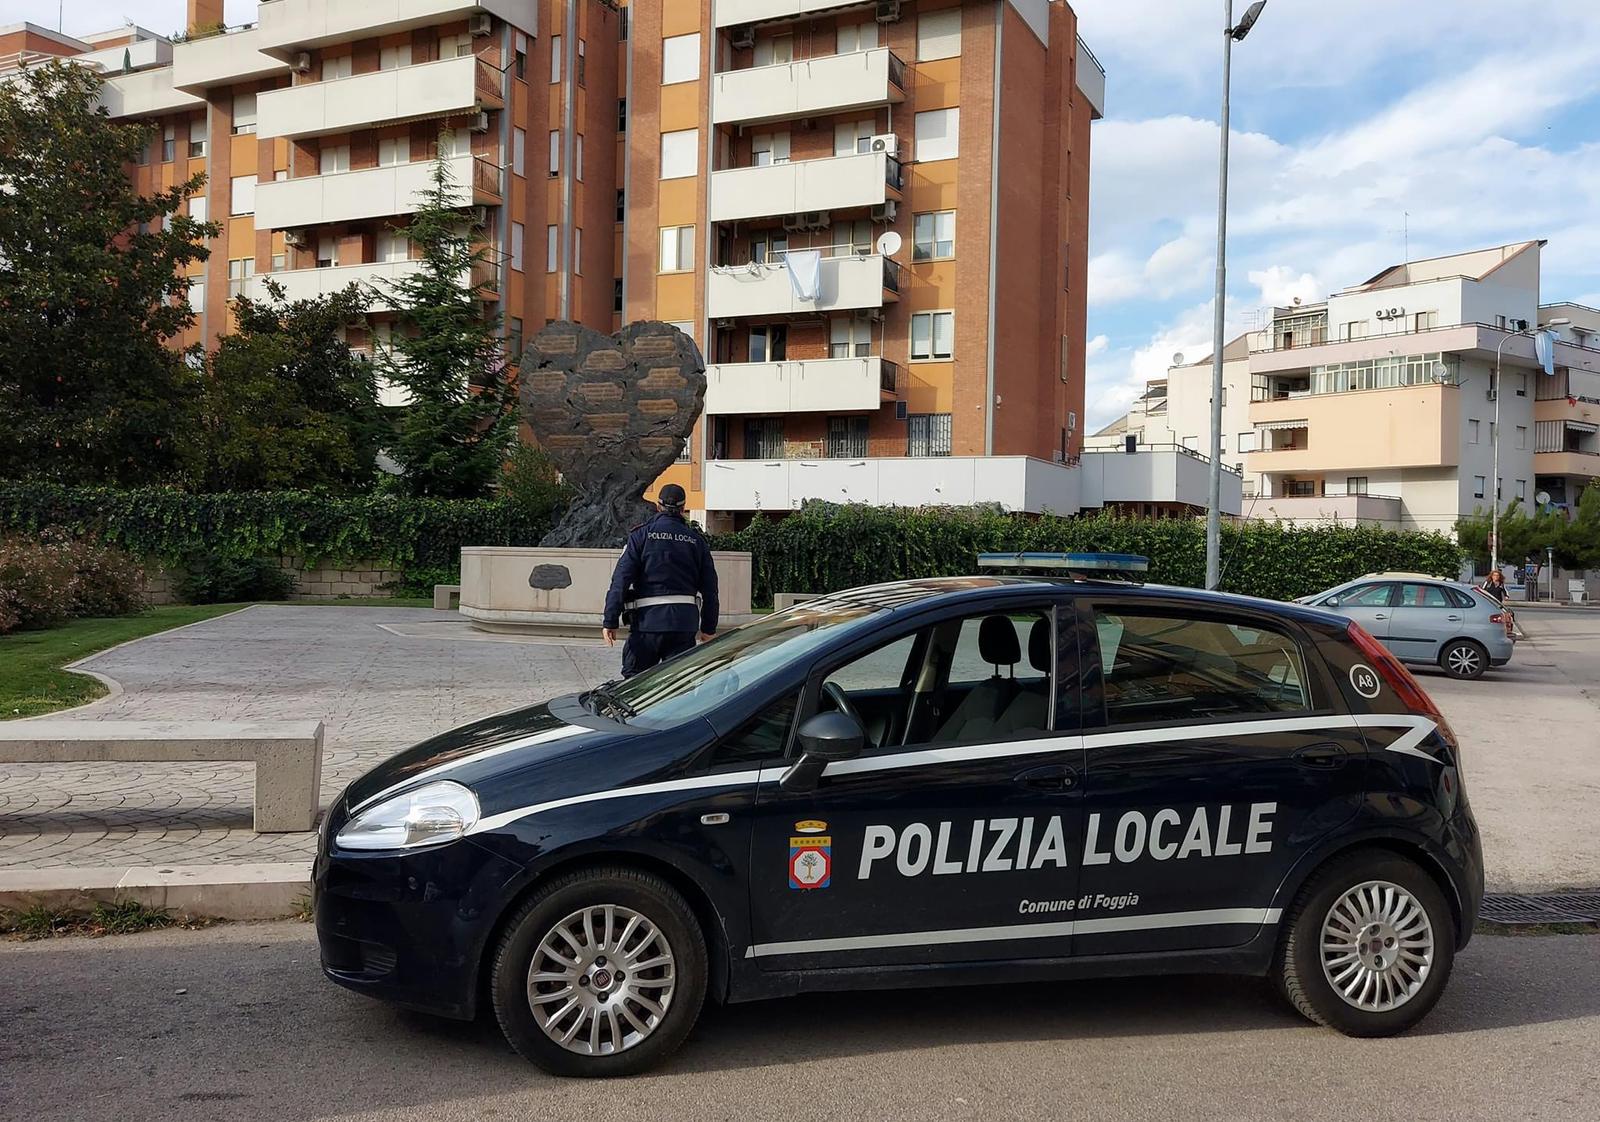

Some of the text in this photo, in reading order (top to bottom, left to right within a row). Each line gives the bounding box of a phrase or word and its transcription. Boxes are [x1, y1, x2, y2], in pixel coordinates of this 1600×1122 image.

[648, 532, 673, 540] POLIZIA
[1359, 674, 1373, 688] A8
[857, 803, 1277, 880] POLIZIA LOCALE
[1019, 892, 1139, 914] Comune di Foggia
